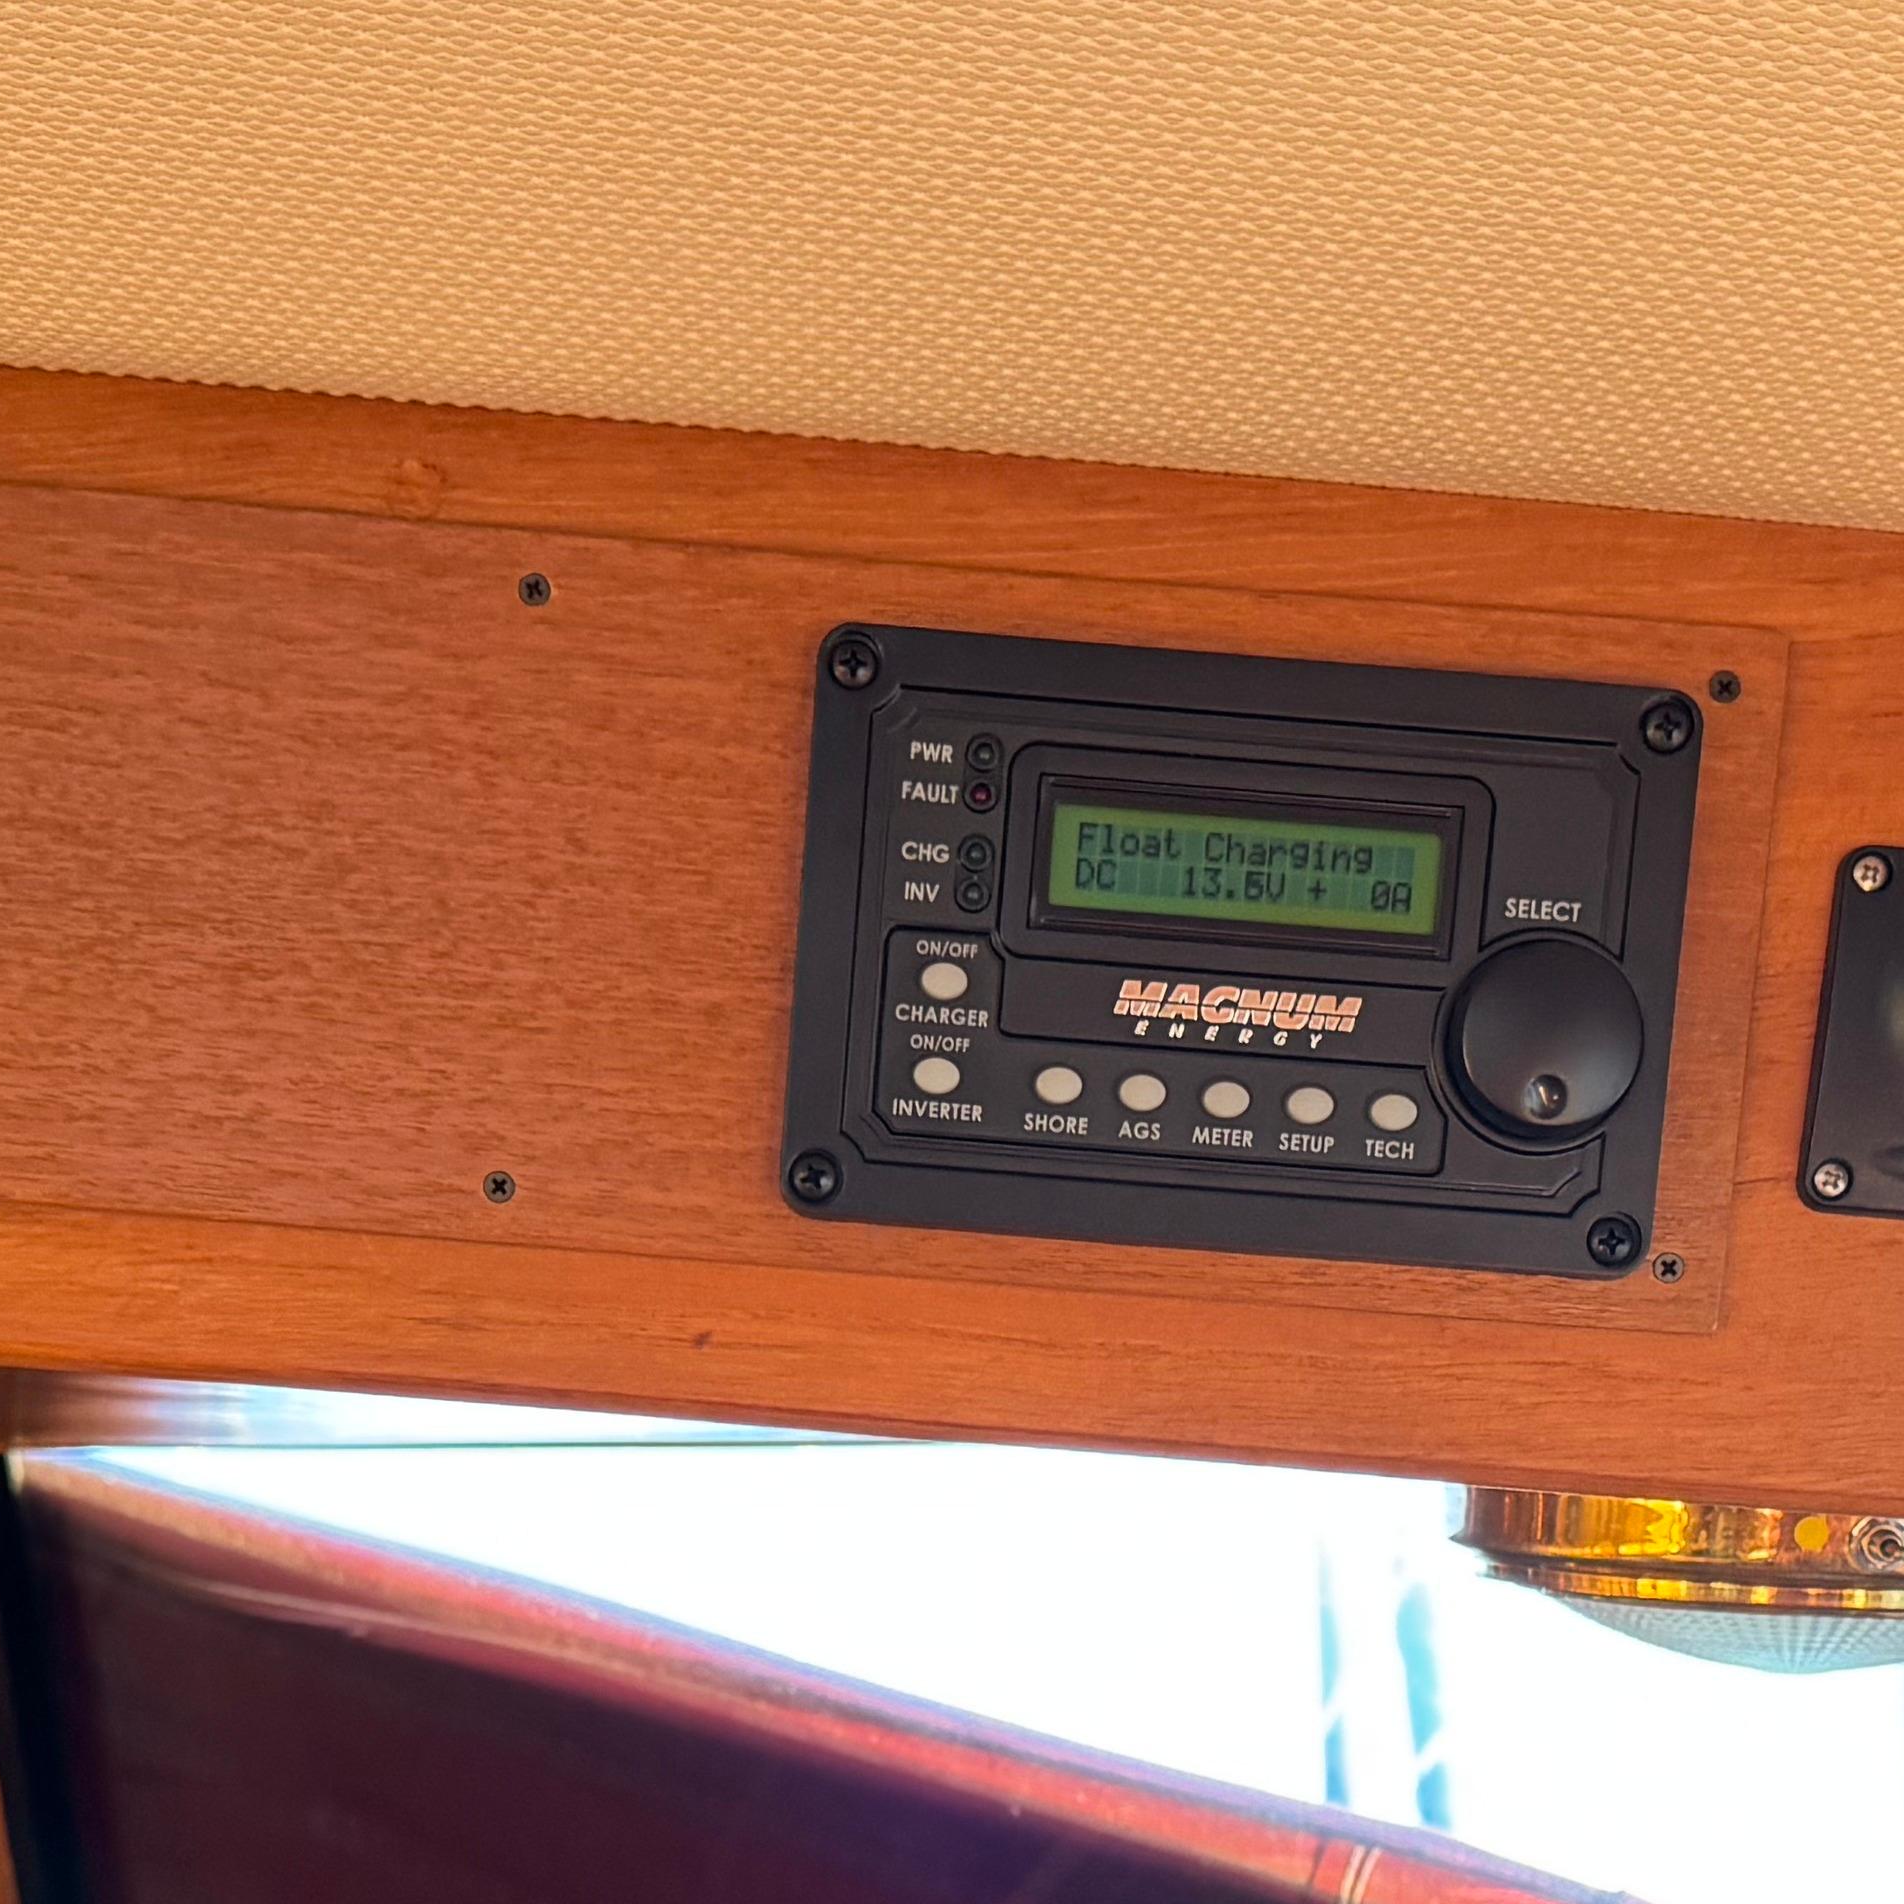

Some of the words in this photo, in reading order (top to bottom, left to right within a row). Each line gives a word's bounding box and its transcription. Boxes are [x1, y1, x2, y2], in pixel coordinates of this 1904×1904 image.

[910, 741, 954, 764] PWR
[901, 781, 959, 805] FAULT
[901, 841, 950, 864] CHG
[1077, 821, 1182, 860] Float
[1204, 832, 1373, 875] Charging
[1074, 858, 1117, 891] DC
[904, 881, 940, 903] INV
[1504, 897, 1582, 923] SELECT
[916, 940, 979, 959] ON/OFF
[895, 1003, 989, 1028] CHARGER
[1113, 978, 1363, 1034] MAGNUM
[910, 1034, 971, 1053] ON/OFF
[1133, 1018, 1323, 1050] ENERGY
[892, 1098, 983, 1123] INVERTER
[1023, 1112, 1089, 1136] SHORE
[1118, 1121, 1161, 1141] AGS
[1192, 1125, 1254, 1149] METER
[1278, 1132, 1336, 1154] SETUP
[1365, 1139, 1415, 1160] TECH
